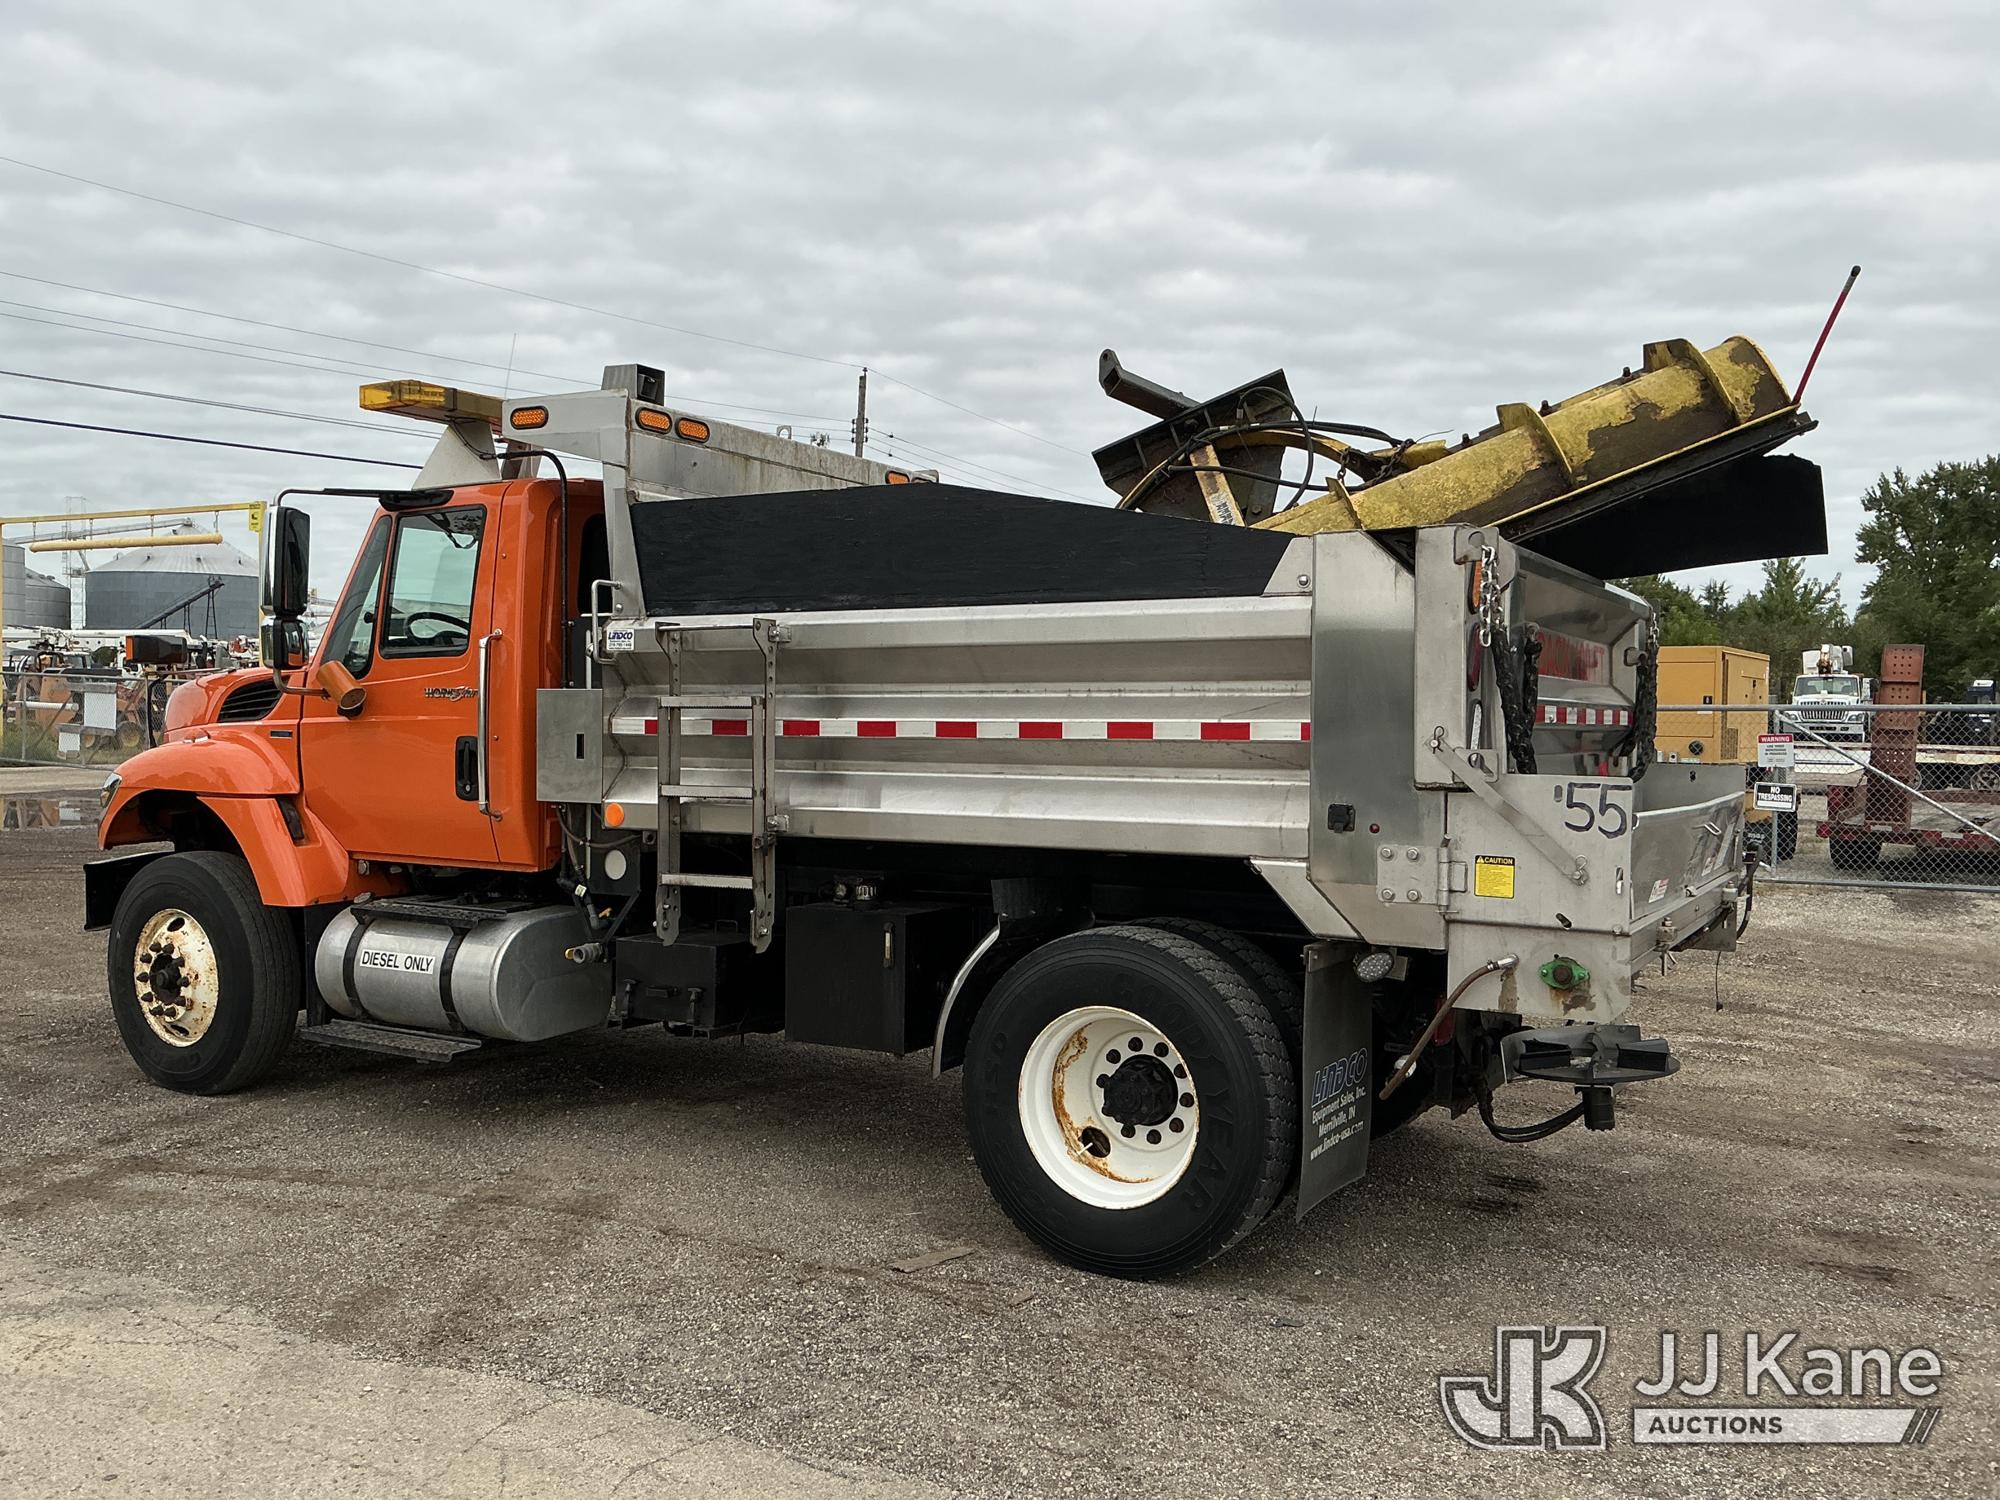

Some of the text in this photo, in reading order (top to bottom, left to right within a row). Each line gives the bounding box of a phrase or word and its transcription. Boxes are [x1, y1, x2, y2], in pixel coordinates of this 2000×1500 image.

[1770, 786, 1781, 794] NO
[1758, 793, 1792, 802] TRESPASSING
[1484, 857, 1513, 865] CAUTION
[362, 951, 432, 972] DIESEL ONLY
[1312, 1098, 1340, 1125] Equipment
[1348, 1105, 1356, 1120] IN
